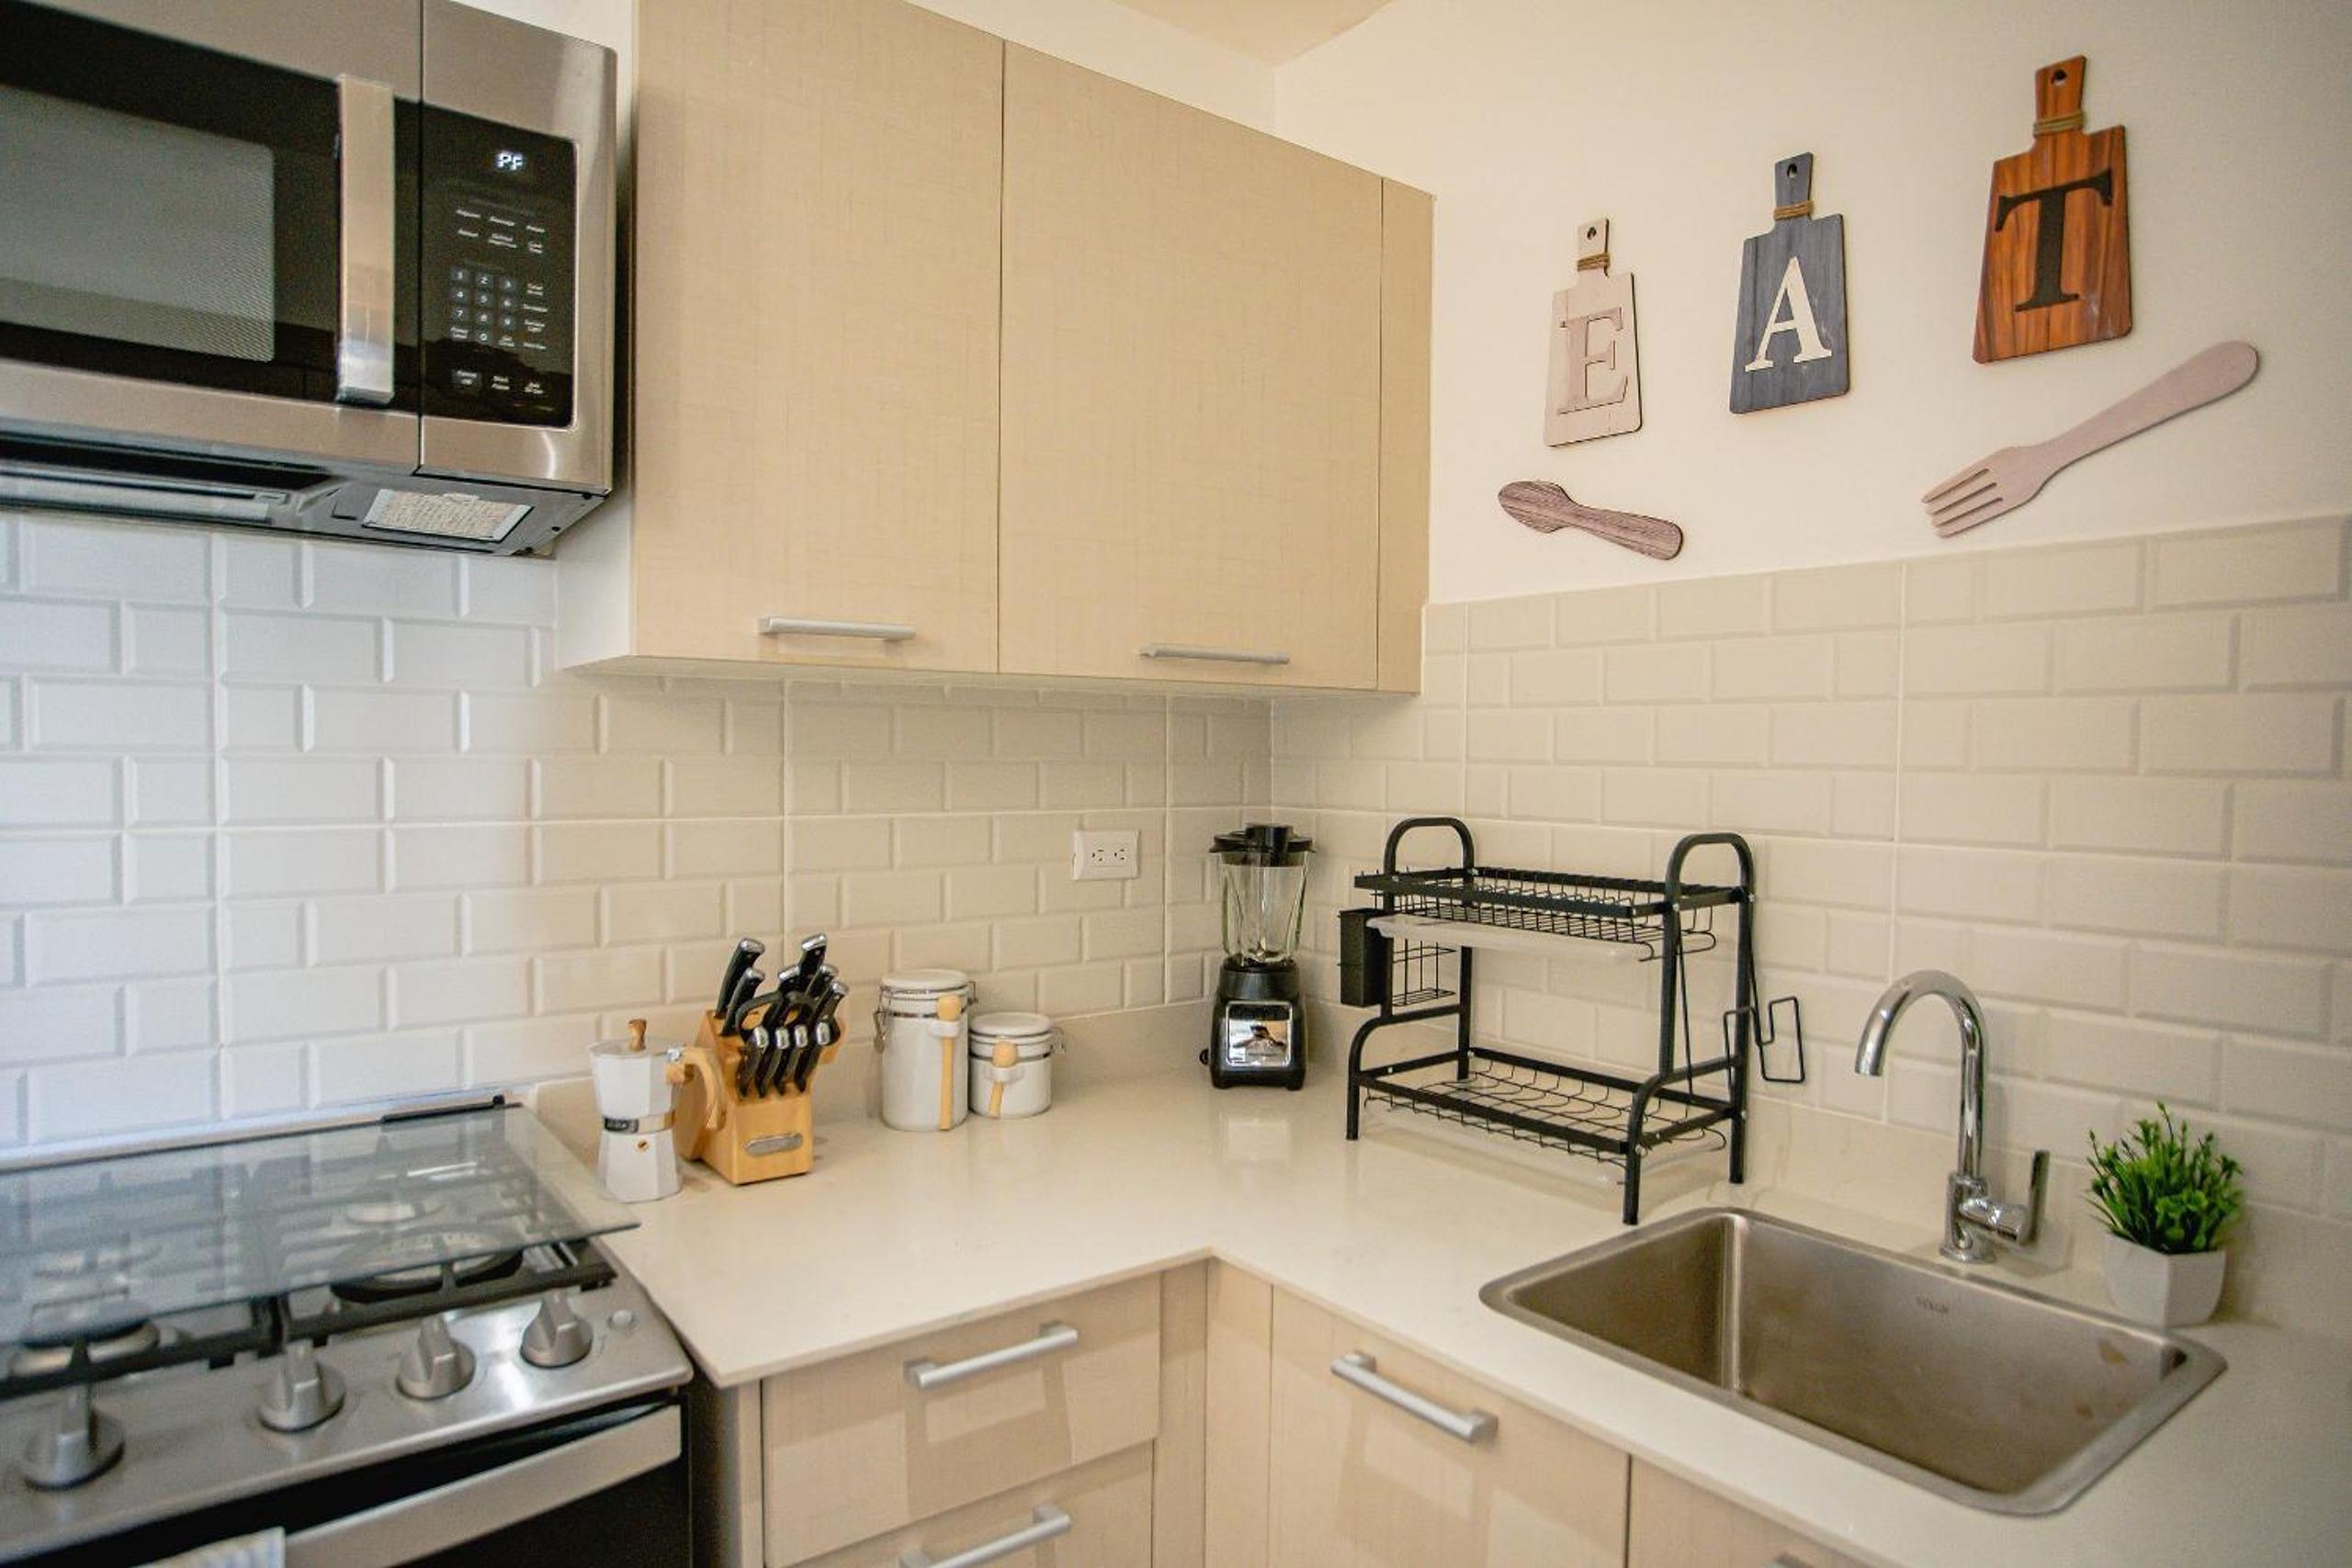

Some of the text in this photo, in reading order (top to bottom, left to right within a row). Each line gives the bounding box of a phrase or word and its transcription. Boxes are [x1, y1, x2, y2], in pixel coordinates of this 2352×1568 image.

[496, 151, 524, 171] PF
[1558, 168, 2112, 415] E A T
[481, 333, 488, 341] 0
